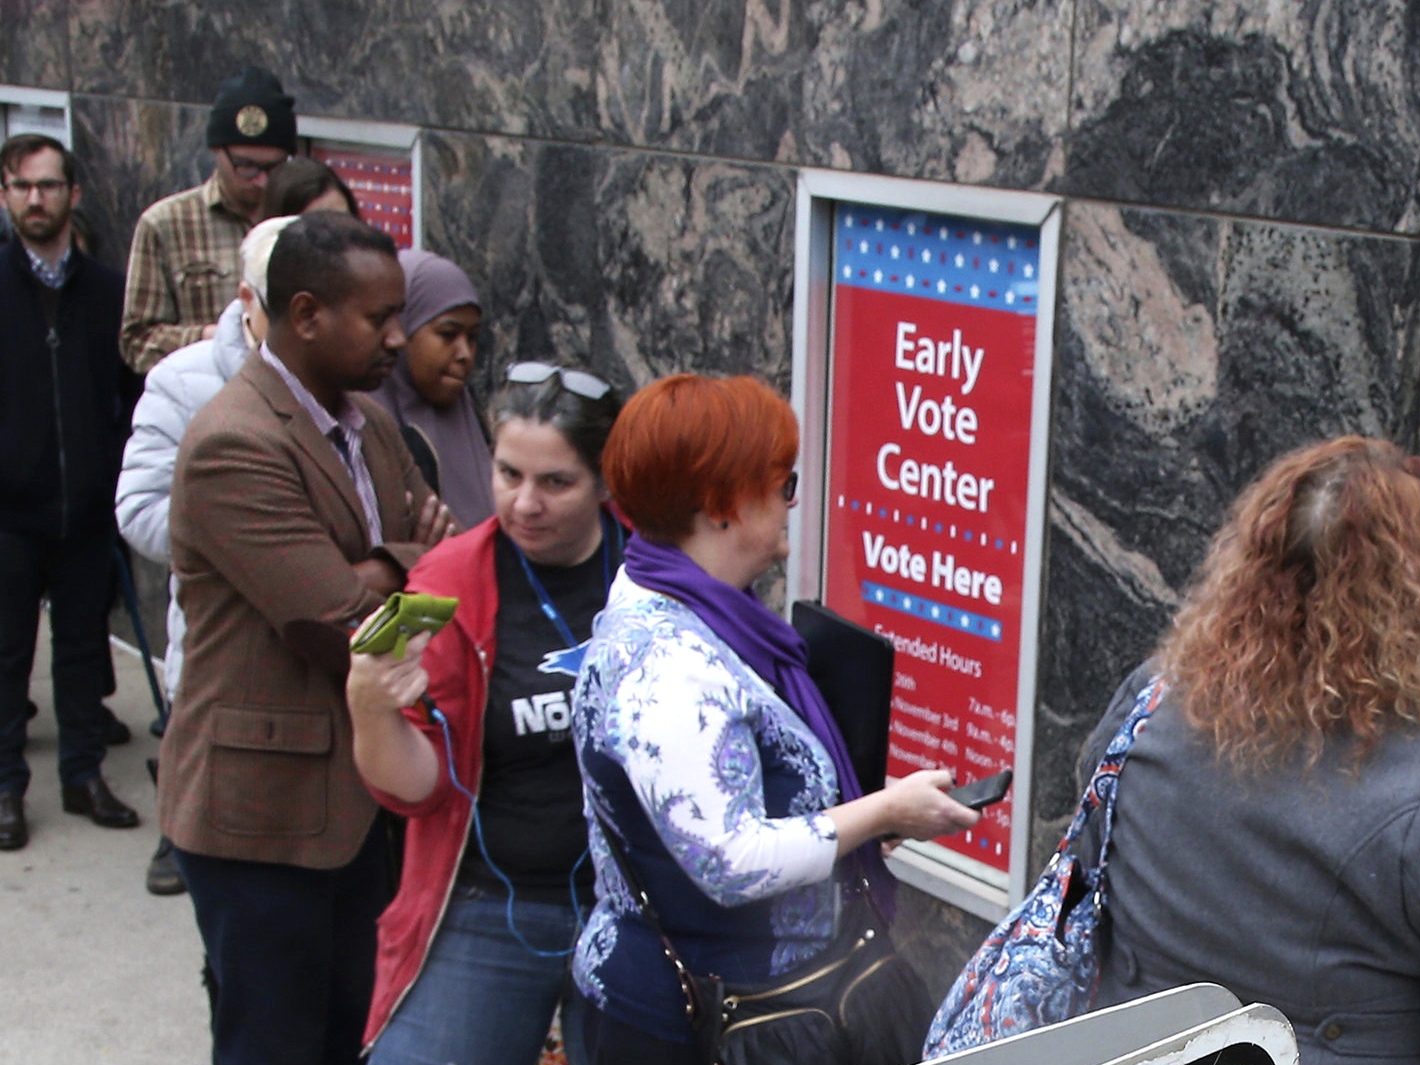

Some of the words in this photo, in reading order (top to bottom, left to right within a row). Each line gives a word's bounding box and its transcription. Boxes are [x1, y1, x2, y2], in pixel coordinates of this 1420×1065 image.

[894, 320, 985, 395] Early
[895, 381, 979, 445] Vote
[876, 442, 995, 513] Center
[862, 530, 927, 583] Vote
[931, 550, 1003, 605] Here
[939, 645, 982, 678] Hours
